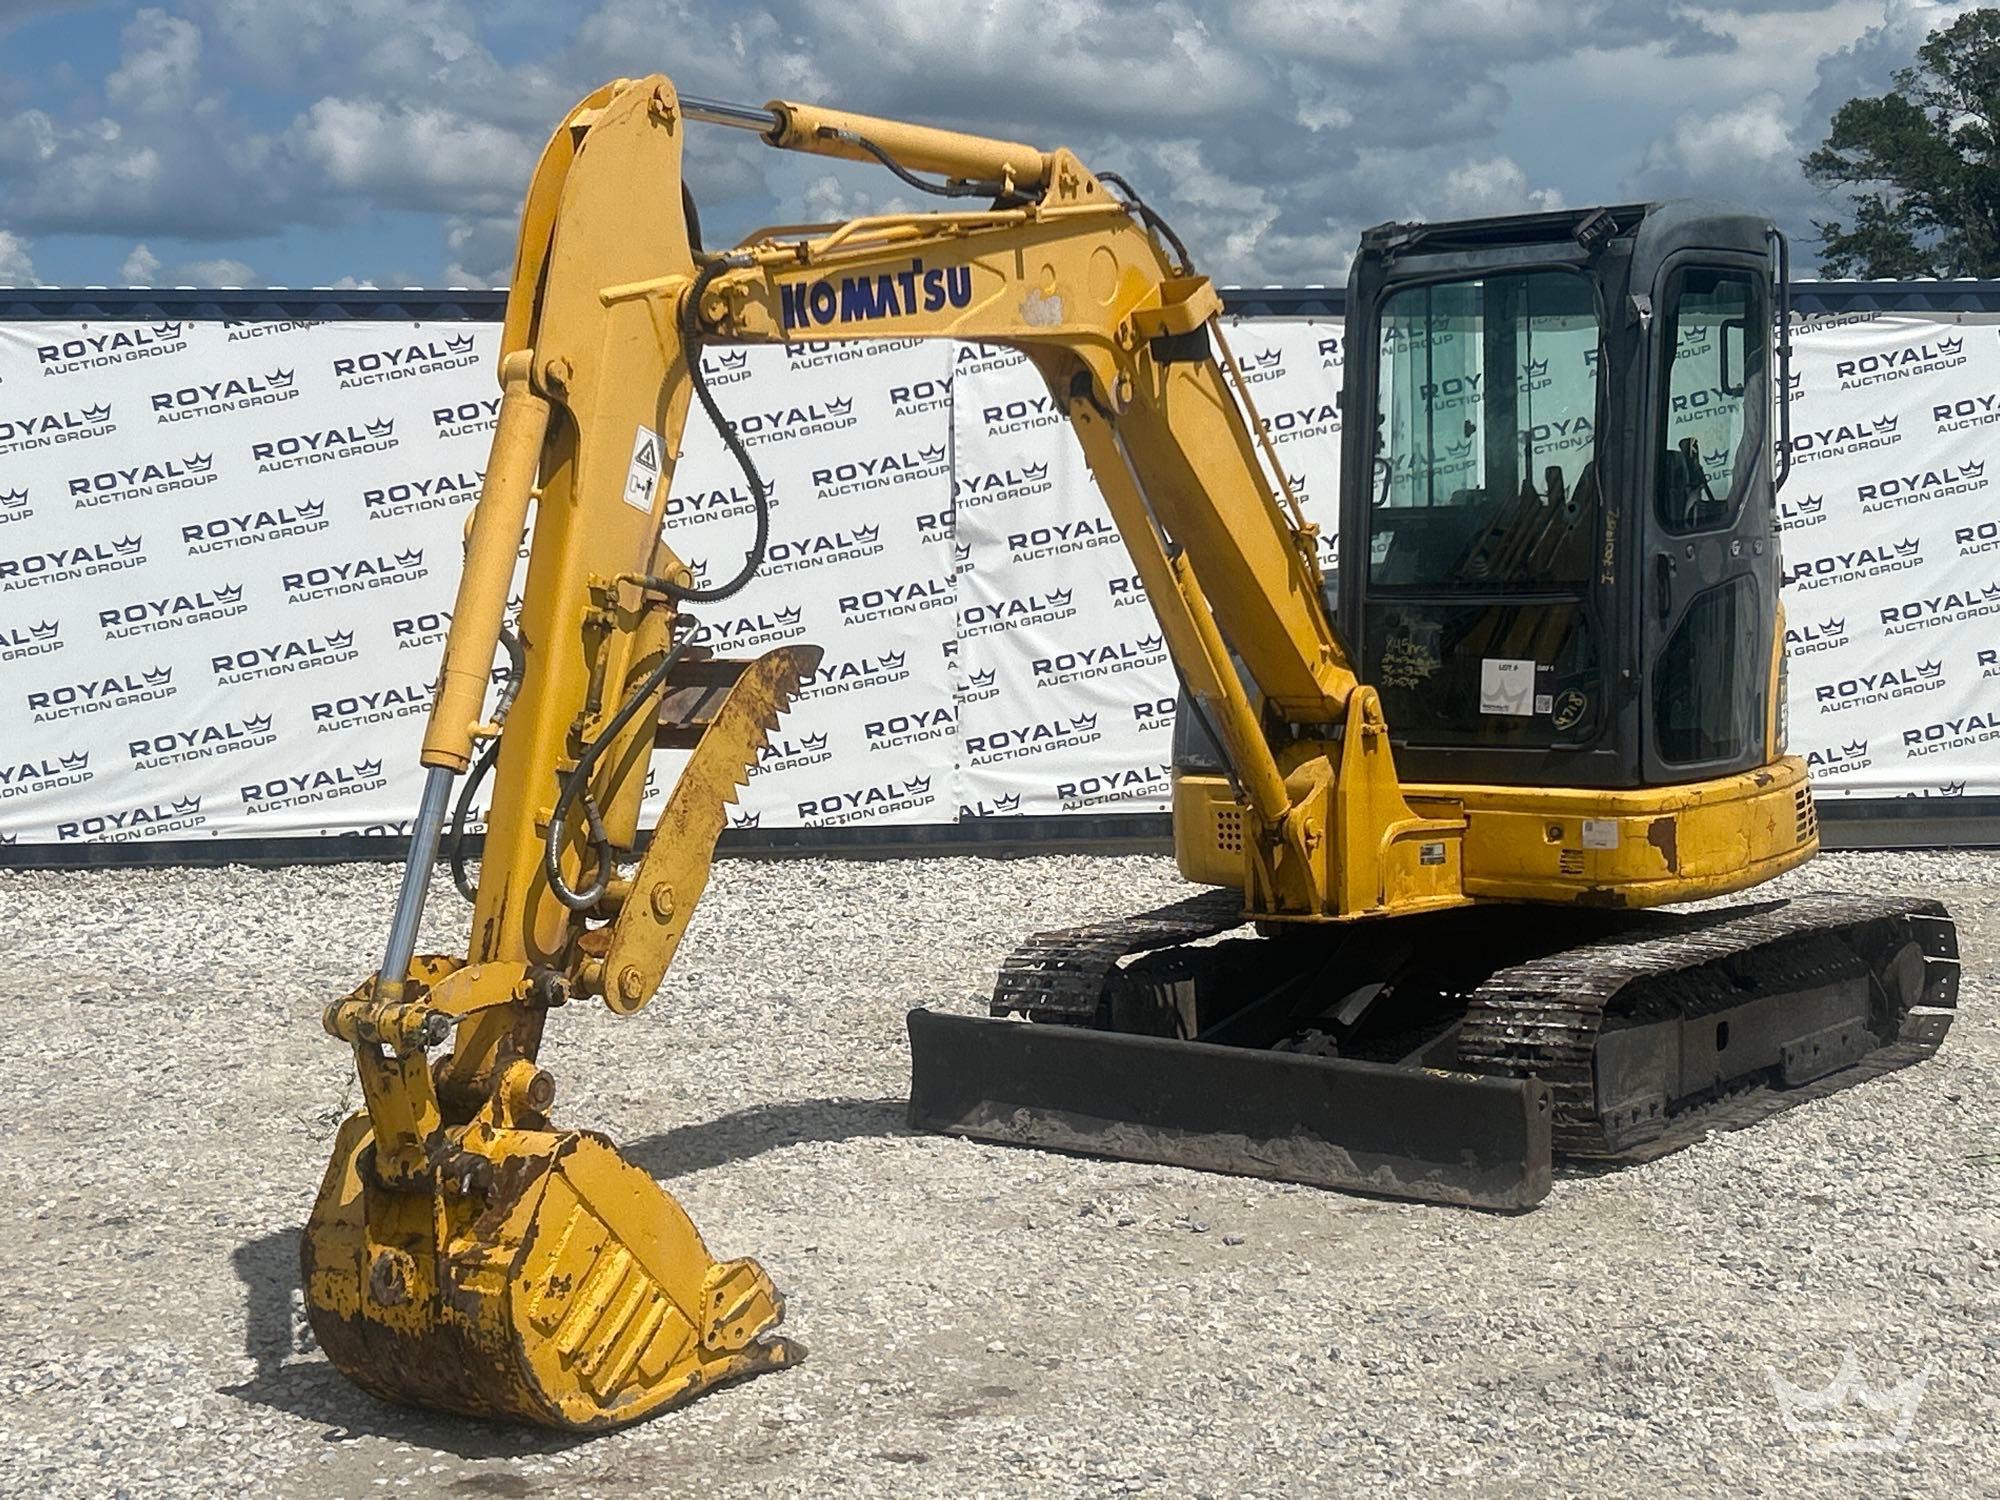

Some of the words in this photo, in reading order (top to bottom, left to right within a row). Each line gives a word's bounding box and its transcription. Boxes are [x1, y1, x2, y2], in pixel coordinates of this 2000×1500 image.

[781, 258, 971, 329] KOMATSU
[36, 329, 154, 364] ROYAL
[1780, 323, 1823, 338] TION
[44, 354, 122, 377] AUCTION
[125, 342, 187, 361] GROUP
[333, 342, 447, 377] ROYAL
[791, 348, 863, 371] AUCTION
[867, 338, 924, 357] GROUP
[971, 355, 1027, 374] GROUP
[1675, 345, 1711, 359] ROUP
[1836, 345, 1938, 379] ROYAL
[340, 367, 416, 390] AUCTION
[419, 355, 479, 374] GROUP
[705, 371, 752, 387] ROUP
[1420, 373, 1481, 400] ROY
[1841, 368, 1910, 391] AUCTION
[1912, 356, 1967, 375] GROUP
[151, 377, 267, 412] ROYAL
[890, 375, 953, 404] ROY
[1672, 388, 1722, 412] ROY
[157, 402, 235, 424] AUCTION
[238, 389, 299, 409] GROUP
[432, 398, 501, 426] ROY
[726, 405, 826, 433] OYAL
[896, 397, 953, 417] AUCTIO
[983, 396, 1056, 424] ROY
[1933, 394, 1997, 422] ROY
[0, 412, 83, 441] OYAL
[0, 437, 51, 455] CTION
[54, 424, 116, 444] GROUP
[439, 420, 498, 439] AUCTIO
[726, 429, 796, 450] UCTION
[799, 417, 857, 436] GROUP
[988, 415, 1059, 437] AUCTION
[252, 426, 366, 461] ROYAL
[258, 451, 335, 474] AUCTION
[338, 439, 399, 458] GROUP
[1534, 436, 1582, 455] CTION
[1777, 447, 1844, 467] UCTION
[1847, 434, 1901, 453] GROUP
[68, 461, 185, 496] ROYAL
[812, 453, 920, 487] ROYAL
[818, 477, 890, 499] AUCTION
[893, 465, 950, 483] GROUP
[957, 470, 1022, 496] YAL
[1857, 468, 1959, 502] ROYAL
[75, 486, 153, 510] AUCTION
[156, 474, 218, 493] GROUP
[363, 473, 476, 508] ROYAL
[369, 497, 446, 520] AUCTION
[449, 491, 482, 505] GRO
[665, 487, 748, 515] OYAL
[957, 494, 993, 509] TION
[996, 482, 1052, 501] GROUP
[1862, 492, 1931, 514] AUCTION
[1934, 479, 1989, 498] GROUP
[0, 509, 33, 524] OUP
[182, 508, 297, 543] ROYAL
[663, 512, 718, 530] CTION
[721, 499, 779, 518] GROP
[1783, 514, 1827, 531] ROUP
[188, 533, 265, 556] AUCTION
[268, 520, 329, 540] GROUP
[745, 533, 853, 565] OYAL
[1007, 517, 1112, 551] ROYAL
[1013, 541, 1083, 563] AUCTION
[1086, 534, 1120, 548] GRO
[1960, 540, 2000, 557] AUCT
[0, 544, 113, 579] ROYAL
[826, 544, 884, 564] GROUP
[1794, 546, 1894, 579] ROYAL
[3, 569, 82, 592] AUCTION
[85, 556, 147, 576] GROUP
[282, 557, 396, 592] ROYAL
[288, 581, 365, 604] AUCTION
[368, 569, 428, 588] GROUP
[1797, 569, 1866, 592] AUCTION
[1869, 557, 1923, 576] GROUP
[99, 592, 215, 628] ROYAL
[838, 579, 946, 614] ROYAL
[844, 603, 916, 626] AUCTION
[920, 595, 957, 610] GRO
[956, 596, 1046, 627] OYAL
[1880, 591, 1982, 624] ROYAL
[105, 617, 183, 641] AUCTION
[186, 605, 248, 624] GROUP
[957, 620, 1017, 640] UCTION
[1020, 608, 1076, 627] GROUP
[1884, 614, 1953, 637] AUCTION
[1956, 604, 2000, 621] GROU
[2, 641, 64, 661] GROUP
[211, 638, 326, 674] ROYAL
[710, 639, 745, 654] TION
[748, 626, 806, 646] GROUP
[1794, 637, 1849, 656] GROUP
[218, 663, 295, 687] AUCTION
[298, 650, 359, 670] GROUP
[1032, 643, 1137, 676] ROYAL
[1037, 666, 1108, 688] AUCTION
[1111, 654, 1167, 673] GROUP
[27, 675, 144, 711] ROYAL
[789, 683, 849, 702] UCTION
[852, 670, 910, 690] GROUP
[955, 689, 999, 705] ROUP
[1815, 668, 1917, 702] ROYAL
[1820, 692, 1889, 714] AUCTION
[1892, 679, 1946, 698] GROUP
[34, 700, 112, 723] AUCTION
[115, 687, 177, 707] GROUP
[311, 686, 425, 721] ROYAL
[317, 710, 393, 734] AUCTION
[397, 703, 432, 717] GRO
[128, 723, 244, 758] ROYAL
[870, 728, 942, 752] AUCTION
[965, 721, 1071, 755] ROYAL
[1902, 712, 2000, 746] ROYAL
[134, 747, 213, 771] AUCTION
[216, 734, 277, 754] GROUP
[774, 752, 832, 771] GROUP
[970, 744, 1042, 767] AUCTION
[1045, 733, 1101, 751] GROUP
[1907, 736, 1976, 758] AUCTION
[0, 760, 61, 784] YAL
[32, 772, 94, 792] GROUP
[1057, 767, 1161, 800] ROYAL
[1818, 759, 1872, 777] GROUP
[240, 767, 355, 803] ROYAL
[246, 792, 324, 816] AUCTION
[326, 779, 387, 799] GROUP
[797, 784, 905, 819] ROYAL
[1062, 790, 1133, 812] AUCTION
[1137, 783, 1169, 796] GRO
[878, 795, 935, 815] GROUP
[57, 804, 172, 840] ROYAL
[144, 816, 206, 836] GROUP
